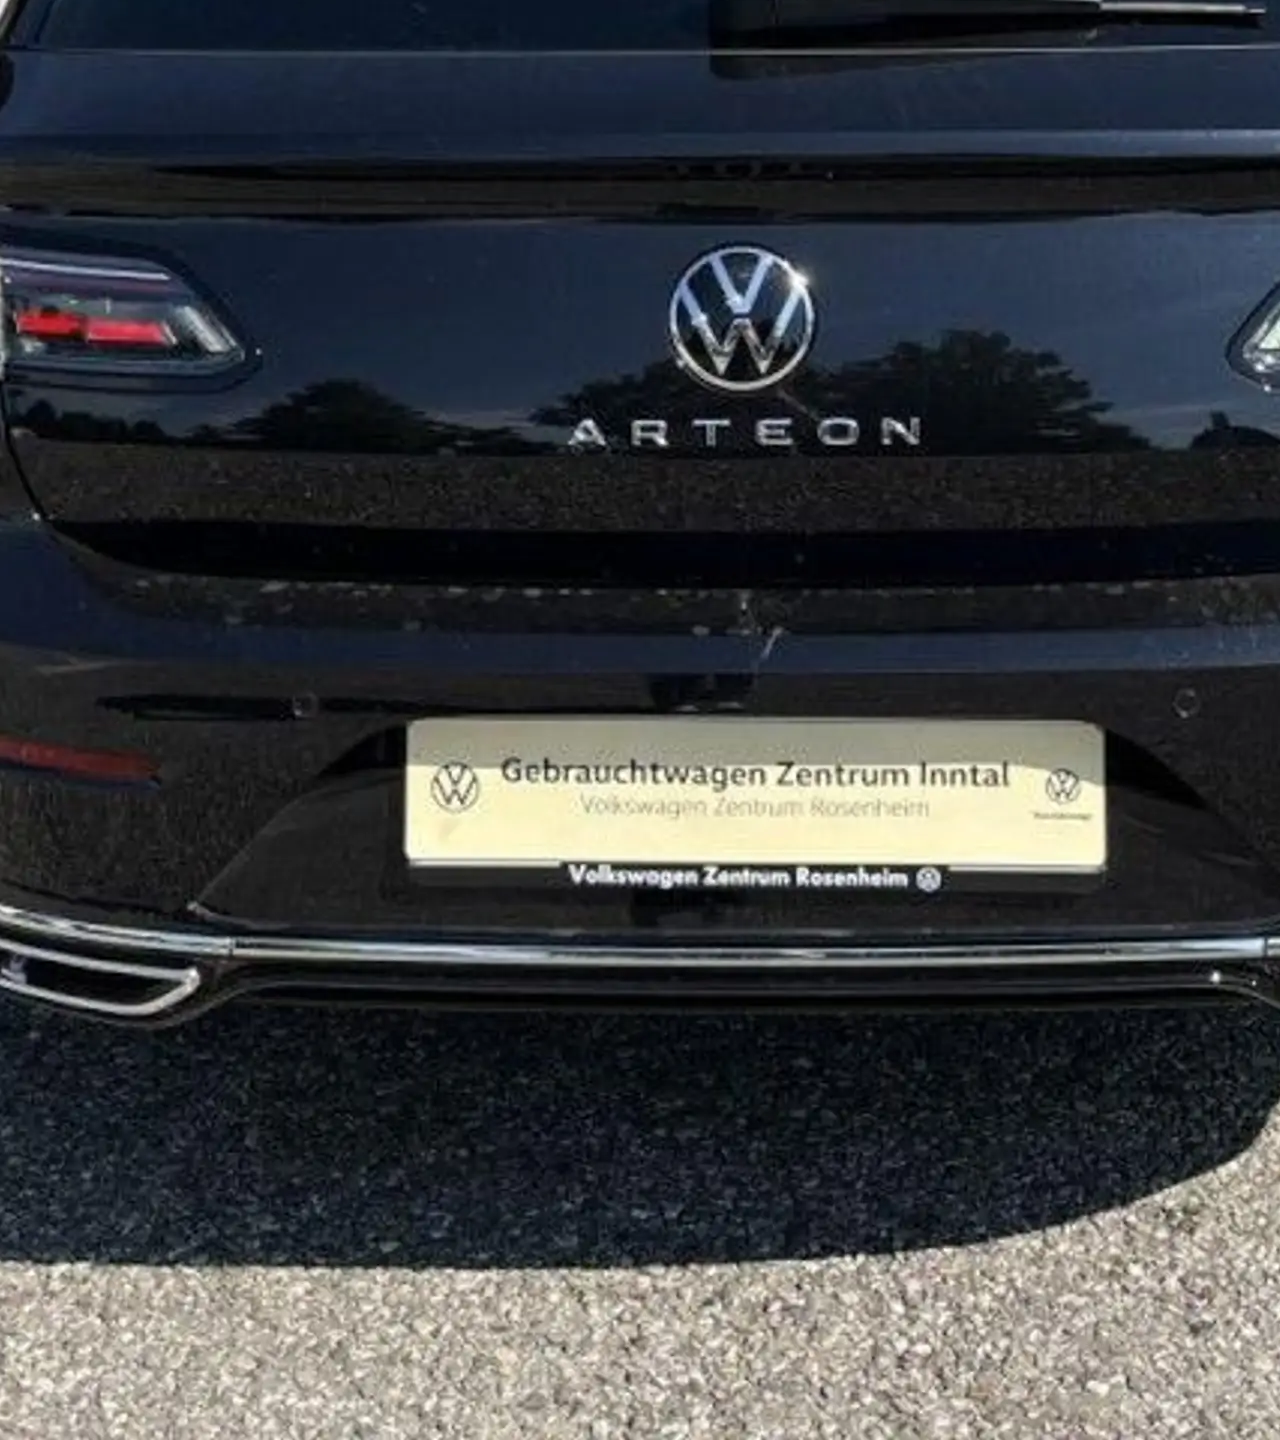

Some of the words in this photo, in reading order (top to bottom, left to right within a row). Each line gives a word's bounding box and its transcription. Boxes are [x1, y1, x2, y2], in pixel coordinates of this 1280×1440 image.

[567, 416, 921, 448] ARTEON
[500, 756, 767, 792] Gebrauchtwagen
[776, 761, 910, 788] Zentrum
[921, 760, 1011, 788] Inntal
[579, 795, 708, 820] Volkswagen
[713, 796, 806, 817] Zentrum
[810, 797, 930, 818] Rosenheim
[568, 864, 699, 889] Volkswagen
[703, 864, 791, 887] Zentrum
[795, 865, 909, 888] Rosenheim
